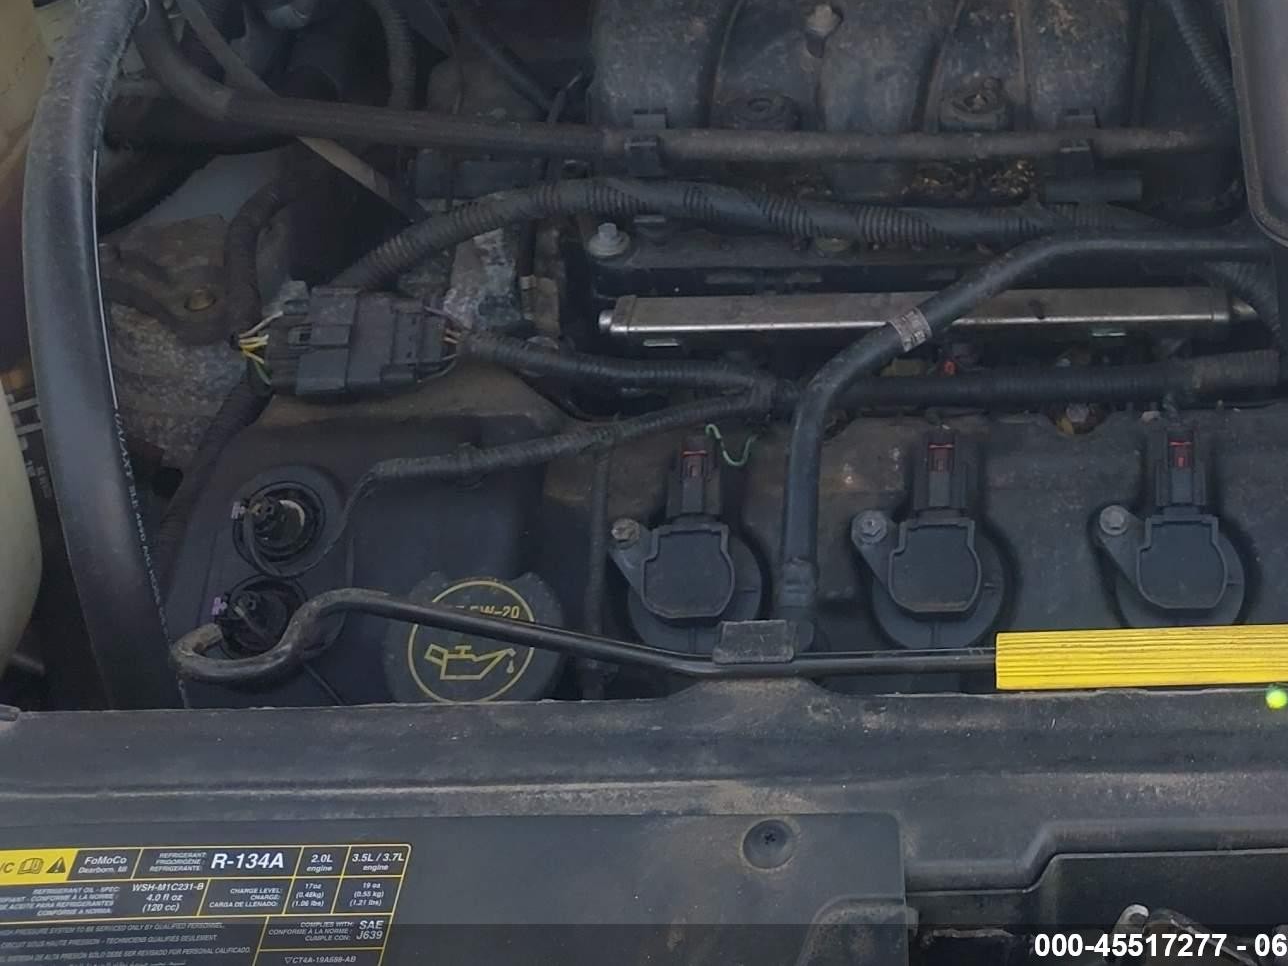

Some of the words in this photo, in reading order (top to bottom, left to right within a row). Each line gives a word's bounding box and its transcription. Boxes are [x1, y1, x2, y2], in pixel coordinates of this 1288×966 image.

[84, 855, 128, 865] FoMoCo
[210, 852, 285, 870] R-134A
[311, 853, 334, 863] 2.0L
[352, 853, 374, 862] 3.5L
[382, 852, 405, 862] 3.7L
[306, 865, 333, 873] engine
[362, 864, 389, 872] engine
[132, 882, 205, 893] WSH-M1C231-B
[146, 894, 162, 902] 4.0
[171, 894, 184, 902] oz
[142, 903, 163, 913] (120
[164, 903, 180, 912] cc)
[358, 920, 385, 930] SAE
[356, 930, 384, 940] J639
